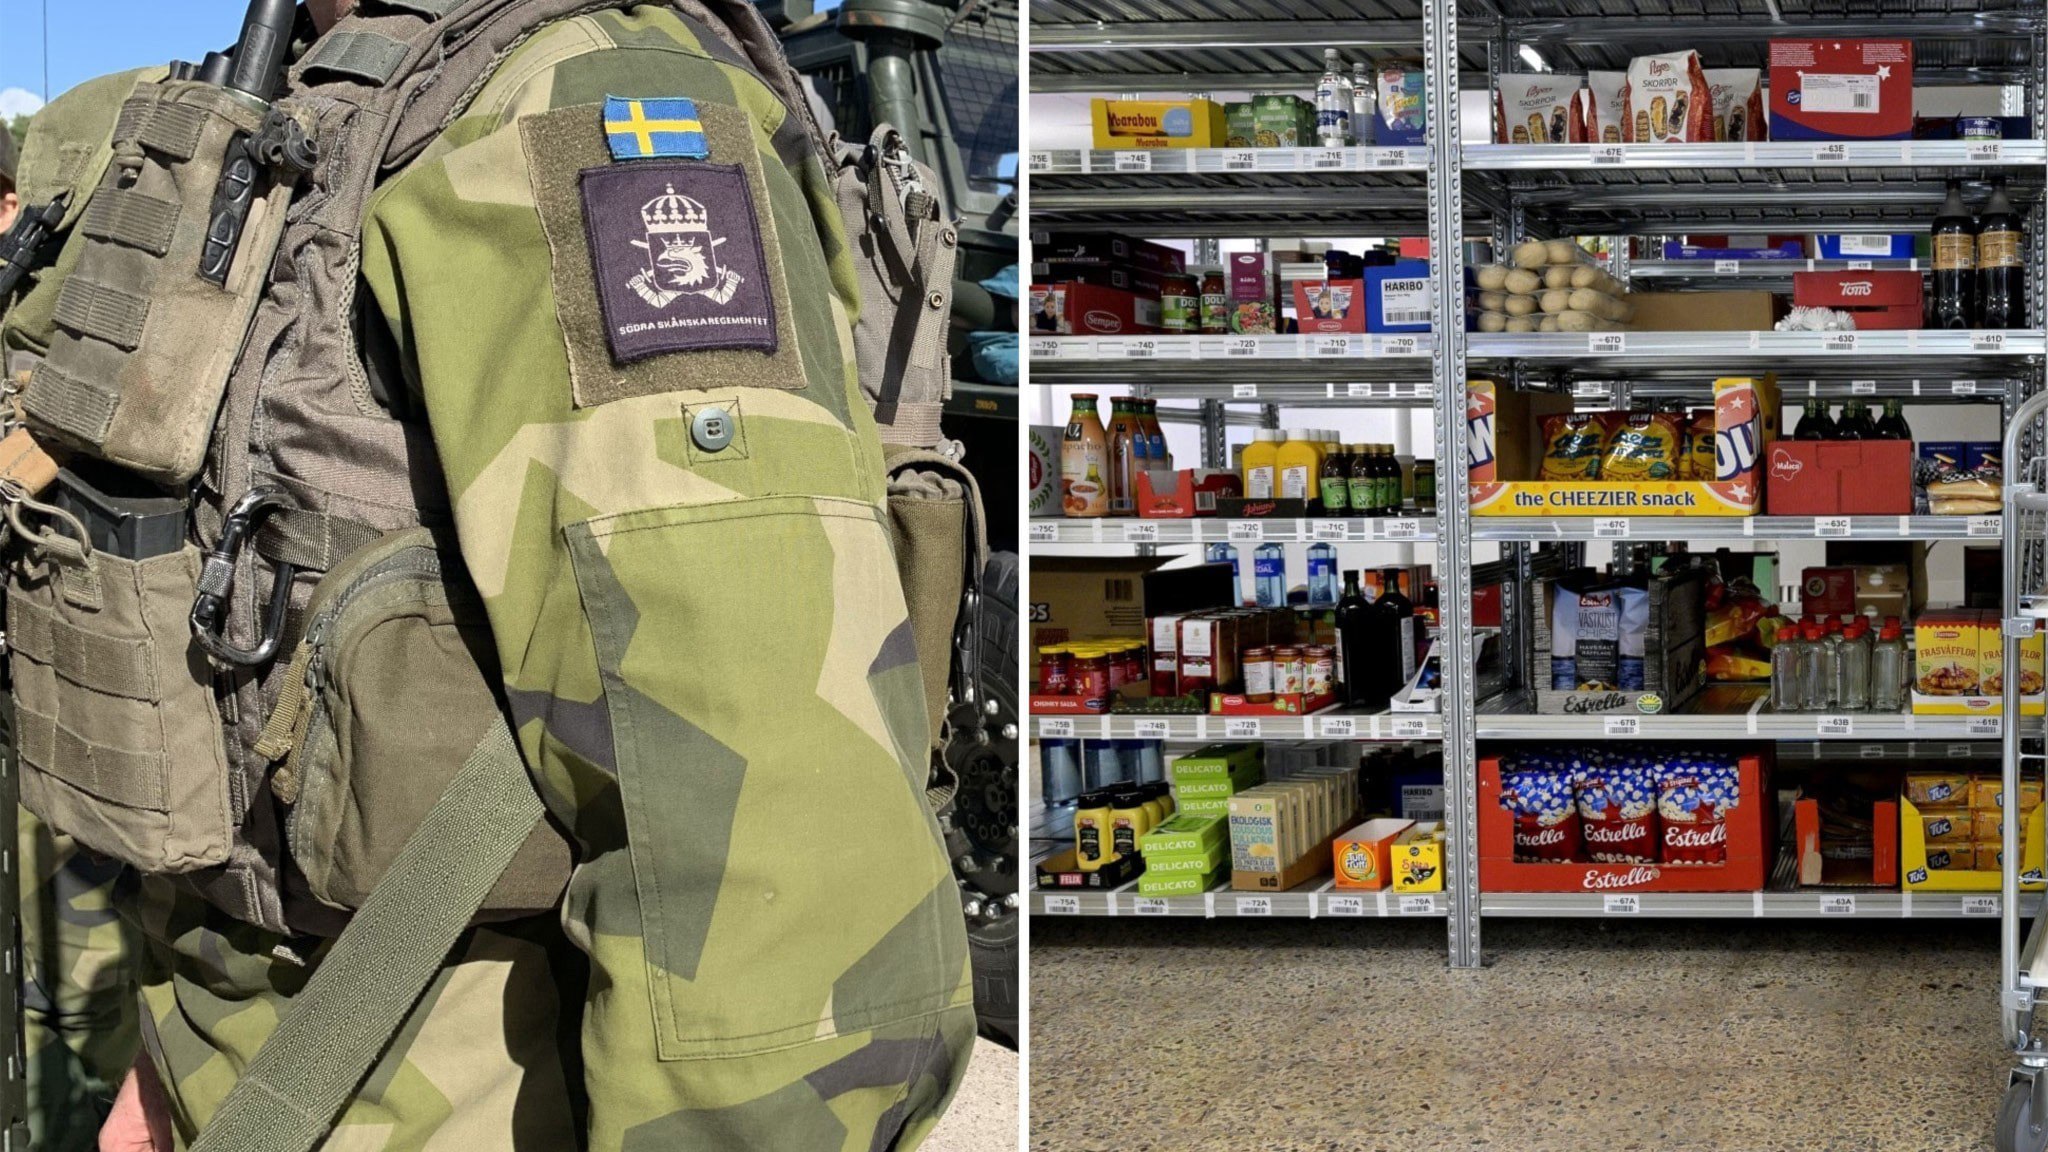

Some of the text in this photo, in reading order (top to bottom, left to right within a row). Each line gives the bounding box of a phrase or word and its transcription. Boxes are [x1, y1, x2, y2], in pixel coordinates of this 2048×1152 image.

[1642, 77, 1678, 88] SKORPOR
[1518, 95, 1557, 107] SKORPOR
[1108, 113, 1157, 128] Marabou
[1135, 138, 1168, 147] Marabou
[1606, 148, 1622, 156] 67E
[1828, 144, 1845, 153] 63E
[1982, 144, 1998, 153] 61E
[1031, 154, 1048, 162] 75E
[1131, 154, 1147, 162] 74E
[1238, 153, 1253, 161] 72E
[1326, 151, 1342, 160] 71E
[1389, 150, 1404, 159] 70E
[1384, 280, 1423, 292] HARIBO
[1840, 281, 1873, 296] Toms
[619, 315, 768, 336] SÖDRA SKÅNSKA REGEMENTET
[1088, 314, 1119, 329] Semper
[1330, 338, 1347, 347] 71D
[1397, 338, 1414, 346] 70D
[1838, 334, 1854, 343] 63D
[1985, 334, 2002, 343] 61D
[1041, 341, 1058, 349] 75D
[1138, 341, 1154, 349] 74D
[1239, 339, 1256, 348] 72D
[1515, 491, 1696, 506] the CHEEZIER snack
[1242, 523, 1259, 531] 72C
[1328, 523, 1345, 531] 71C
[1399, 521, 1416, 530] 70C
[1830, 519, 1847, 528] 63C
[1983, 519, 2000, 527] 61C
[1038, 525, 1054, 533] 75C
[1138, 525, 1155, 533] 74C
[1578, 609, 1616, 629] VÄSTKUST
[1577, 628, 1617, 638] CHIPS
[1563, 693, 1628, 714] Estrella
[1054, 720, 1070, 729] 75B
[1149, 721, 1166, 730] 74B
[1240, 721, 1257, 729] 72B
[1335, 719, 1352, 728] 71B
[1407, 720, 1424, 729] 70B
[1620, 718, 1636, 727] 67B
[1832, 718, 1849, 726] 63B
[1982, 718, 1998, 726] 61B
[1175, 764, 1222, 774] DELICATO
[1179, 784, 1228, 794] DELICATO
[1402, 788, 1433, 796] HARIBO
[1928, 785, 1951, 799] TUC
[1183, 801, 1229, 811] DELICATO
[1231, 815, 1273, 826] EKOLOGISK
[1584, 822, 1646, 842] Estrella
[1929, 820, 1951, 835] TUC
[1144, 840, 1197, 851] DELICATO
[1928, 853, 1950, 868] TUC
[1151, 861, 1203, 871] DELICATO
[1059, 873, 1082, 885] FELIX
[1582, 867, 1653, 889] Estrella
[1909, 869, 1926, 882] TUC
[1143, 880, 1197, 892] DELICATO
[1149, 898, 1165, 906] 74A
[1251, 899, 1268, 907] 72A
[1343, 899, 1360, 907] 71A
[1414, 898, 1431, 906] 70A
[1619, 897, 1636, 905] 67A
[1835, 897, 1852, 905] 63A
[1977, 899, 1994, 907] 61A
